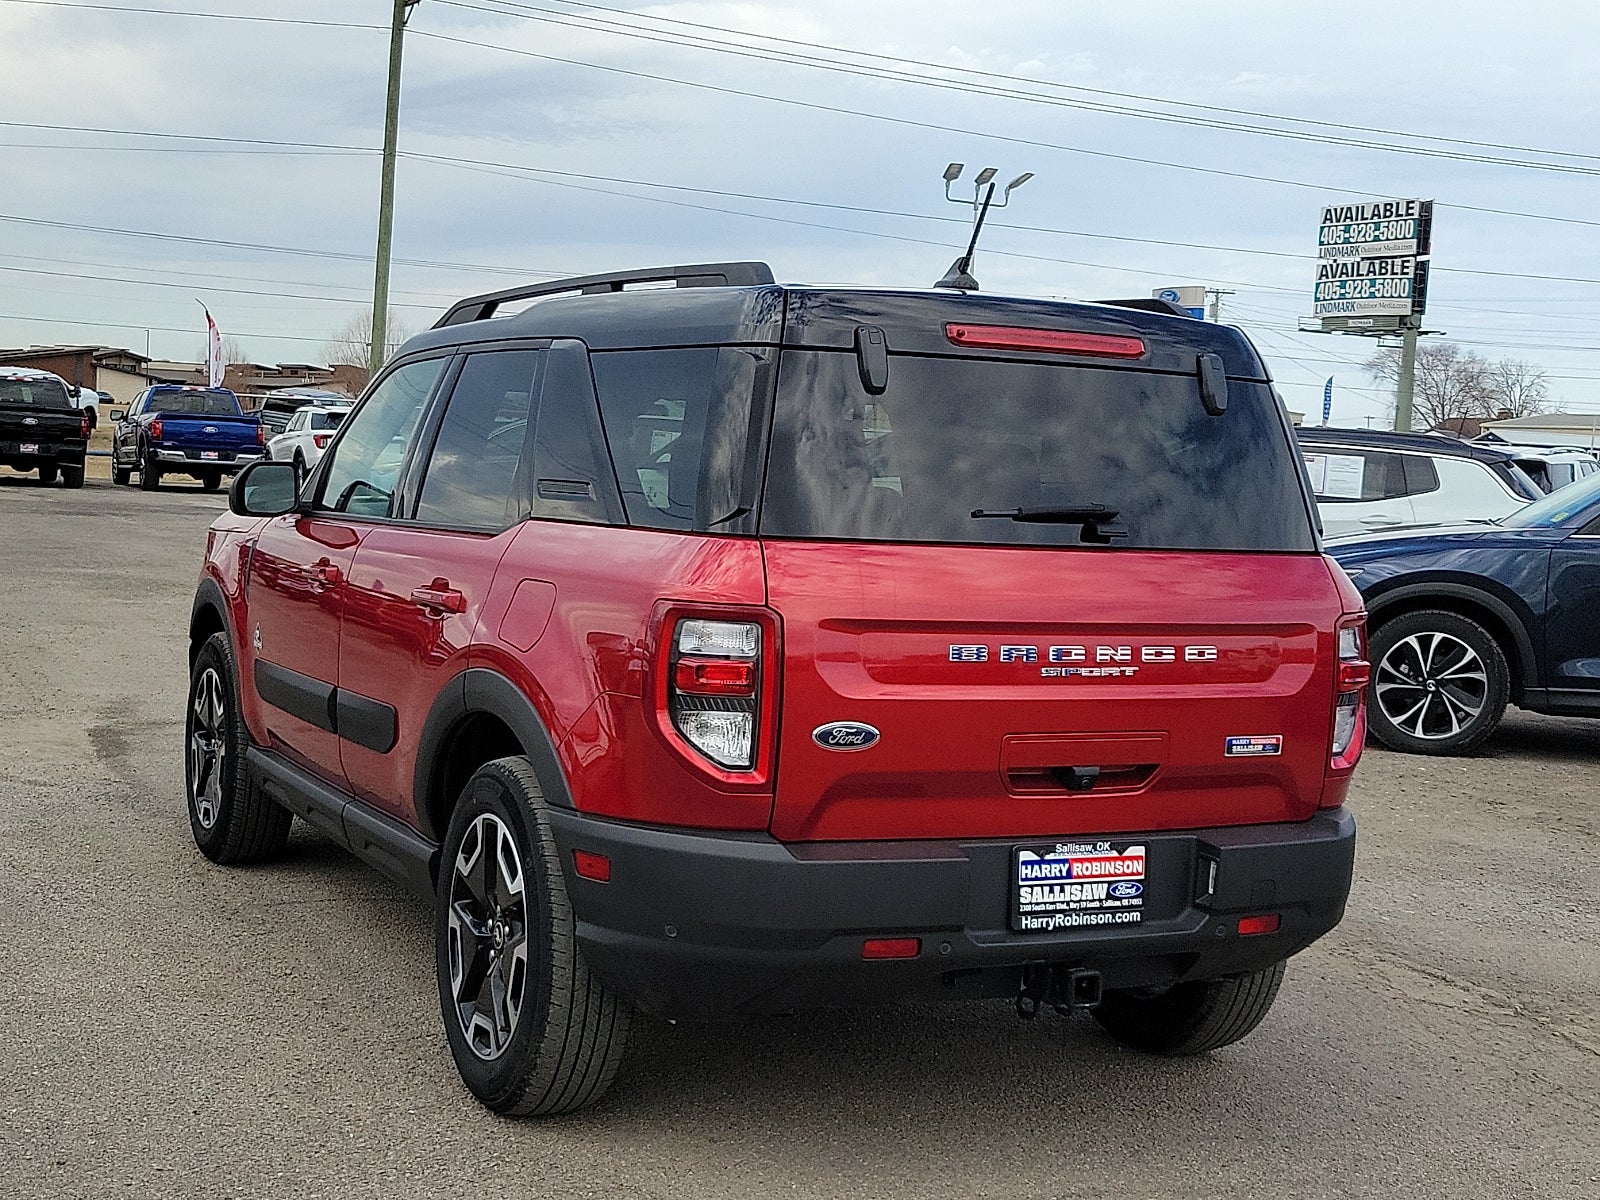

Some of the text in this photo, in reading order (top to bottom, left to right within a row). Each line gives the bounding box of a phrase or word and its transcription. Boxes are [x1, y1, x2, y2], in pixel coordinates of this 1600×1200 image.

[1322, 201, 1416, 224] AVAILABLE
[1321, 220, 1414, 245] 405-928-5800
[1319, 245, 1360, 259] LINDMARK
[1318, 259, 1411, 280] AVAILABLE
[1316, 279, 1409, 300] 405-928-5800
[1315, 301, 1356, 314] LINDMARK
[949, 644, 1218, 662] BRONCO
[1040, 666, 1139, 677] SPORT
[828, 727, 866, 744] Ford
[1055, 841, 1111, 853] Sallisaw, OK
[1021, 859, 1143, 879] HARRY ROBINSON
[1020, 882, 1137, 903] SALLISAW Ford
[1022, 912, 1141, 930] HarryRobinson.com
